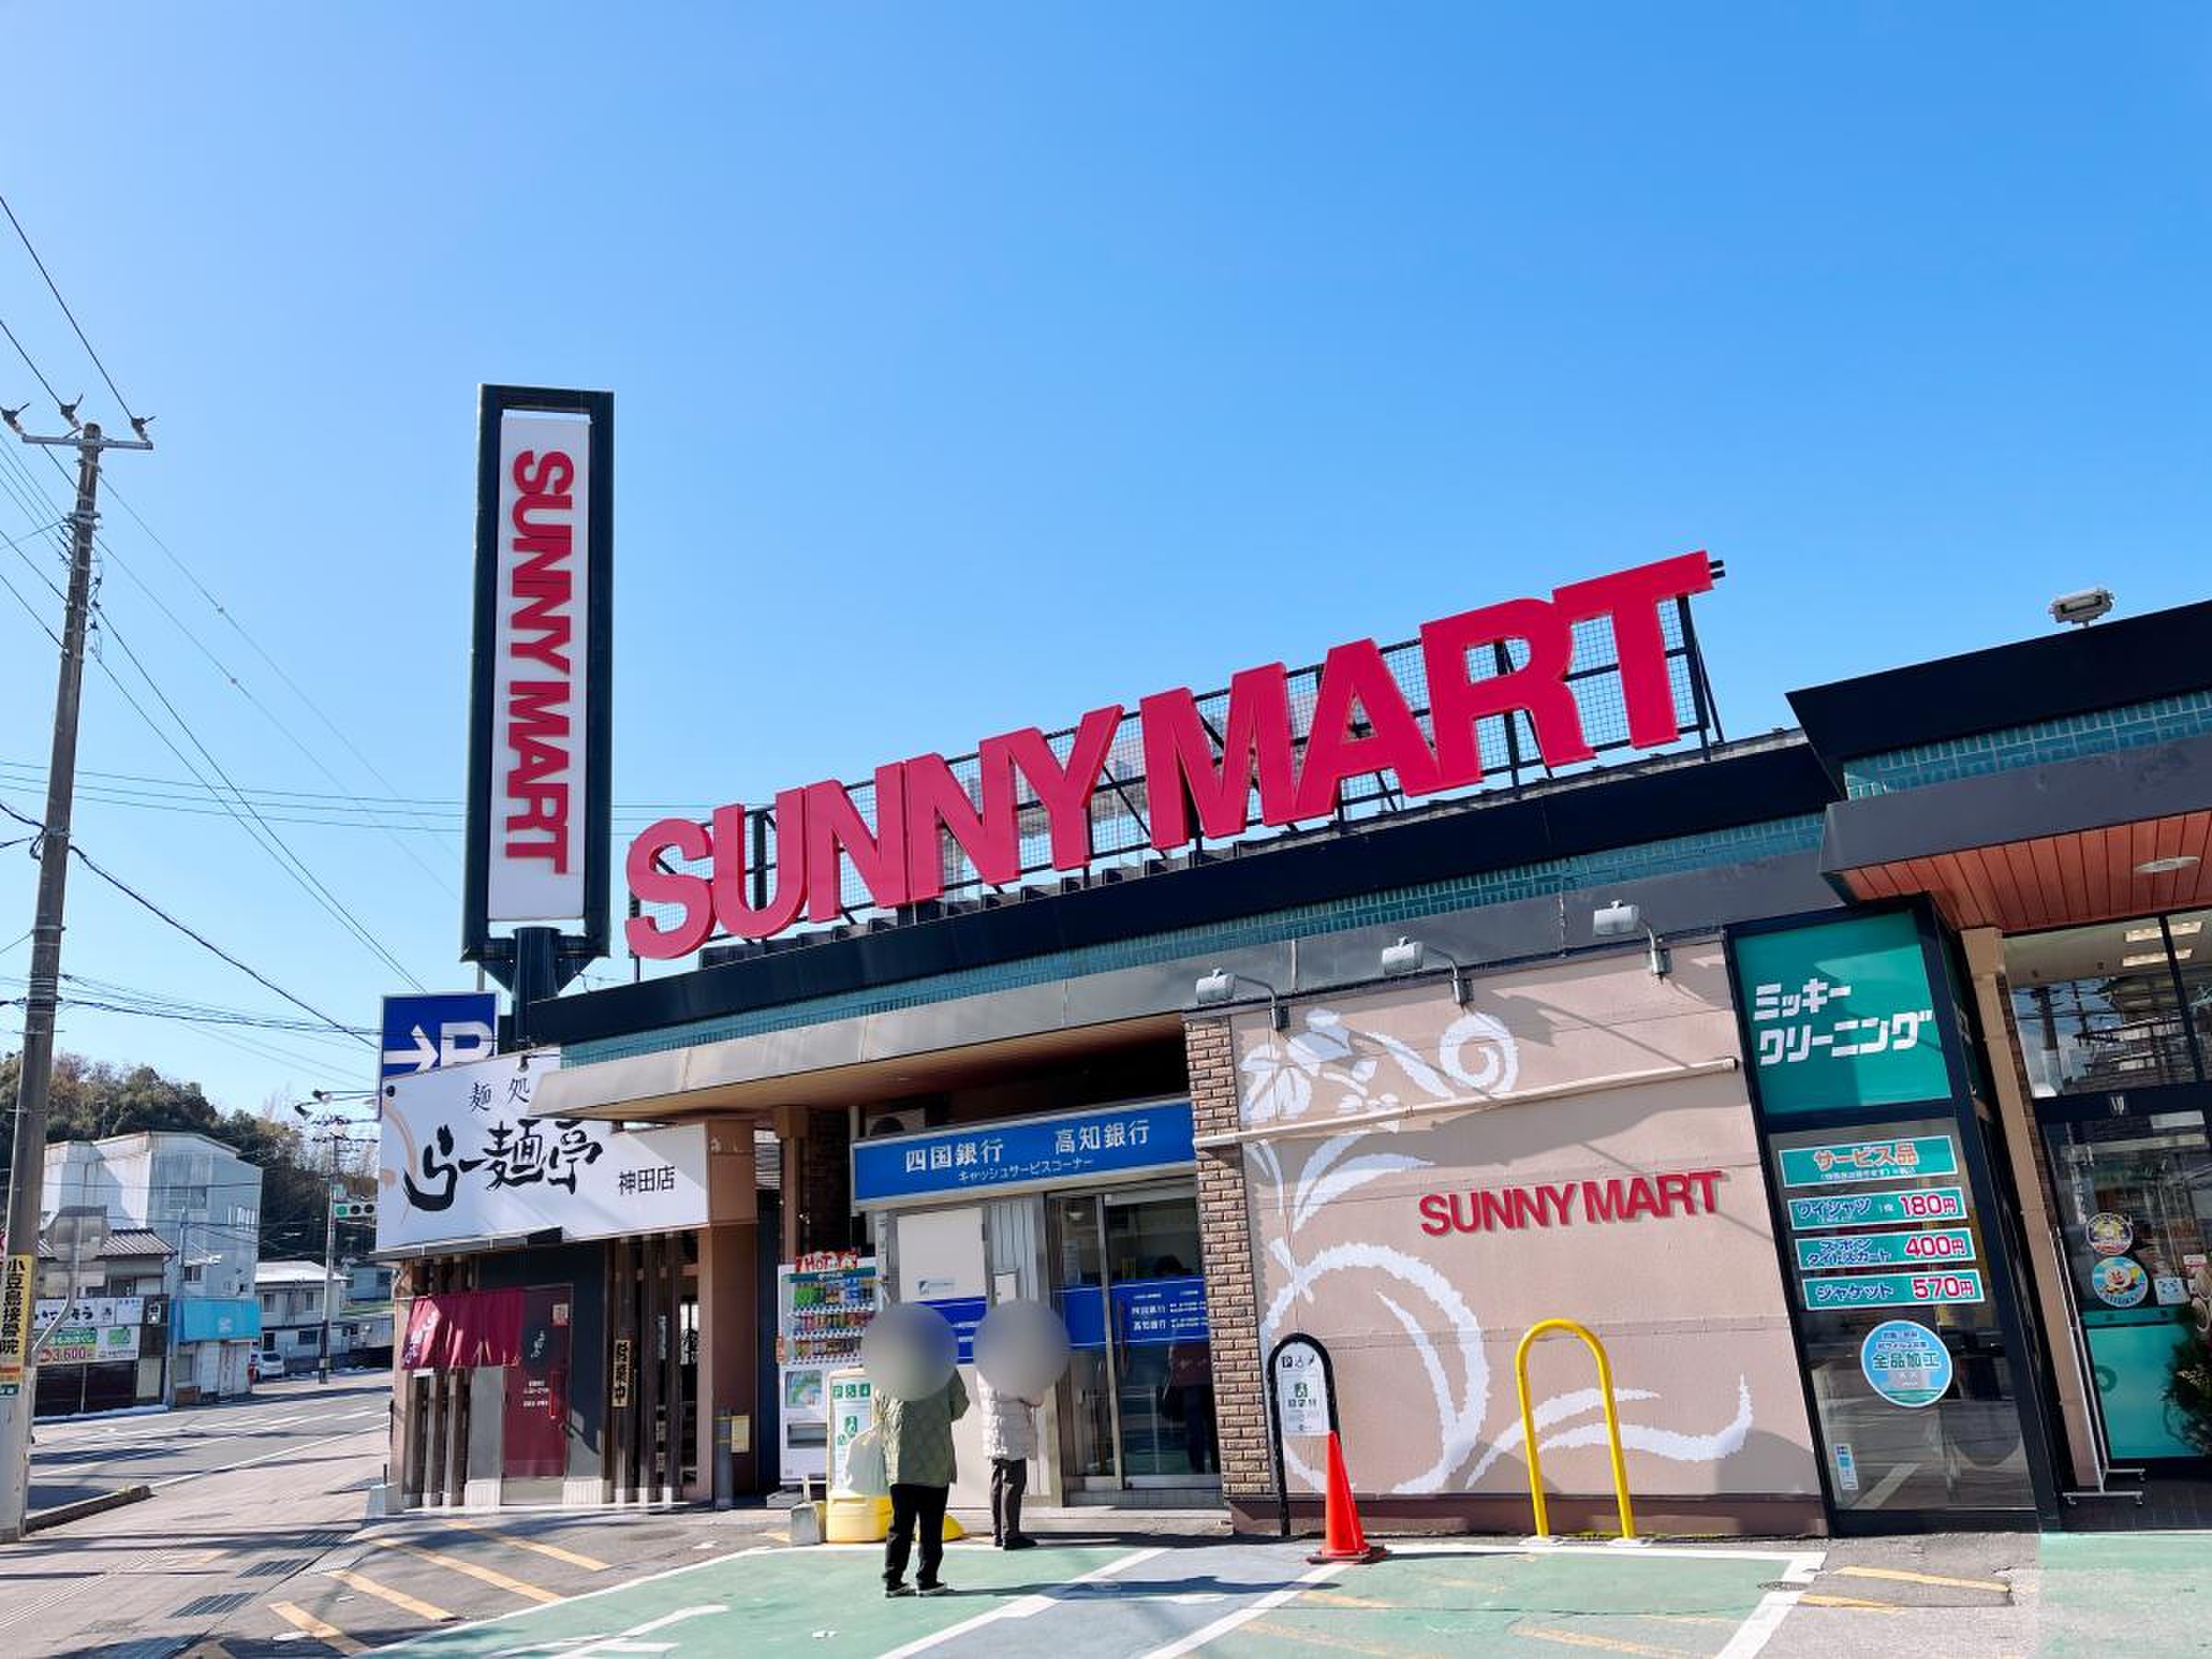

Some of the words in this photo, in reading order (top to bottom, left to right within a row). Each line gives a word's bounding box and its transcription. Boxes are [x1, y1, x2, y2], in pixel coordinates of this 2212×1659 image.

[512, 450, 575, 674] SUNNY
[627, 704, 1124, 960] SUNNY
[1139, 549, 1714, 851] MART
[506, 681, 571, 874] MART
[1754, 978, 1852, 1021] ミッキー
[440, 1021, 495, 1065] P
[1759, 1010, 1933, 1066] クリーニング
[905, 1139, 1005, 1173] 四国銀行
[1055, 1120, 1150, 1155] 高知銀行
[1814, 1143, 1919, 1171] サービス品
[618, 1165, 676, 1195] 神田店
[959, 1159, 1094, 1182] キャッシュサービスコーナー
[1418, 1183, 1575, 1237] SUNNY
[1581, 1170, 1724, 1224] MART
[1798, 1199, 1872, 1219] ワイシャツ
[1900, 1194, 1958, 1216] 180円
[1904, 1235, 1966, 1257] 400円
[1815, 1282, 1894, 1301] ジャケット
[1912, 1277, 1975, 1300] 570円
[1872, 1351, 1942, 1371] 全品加工
